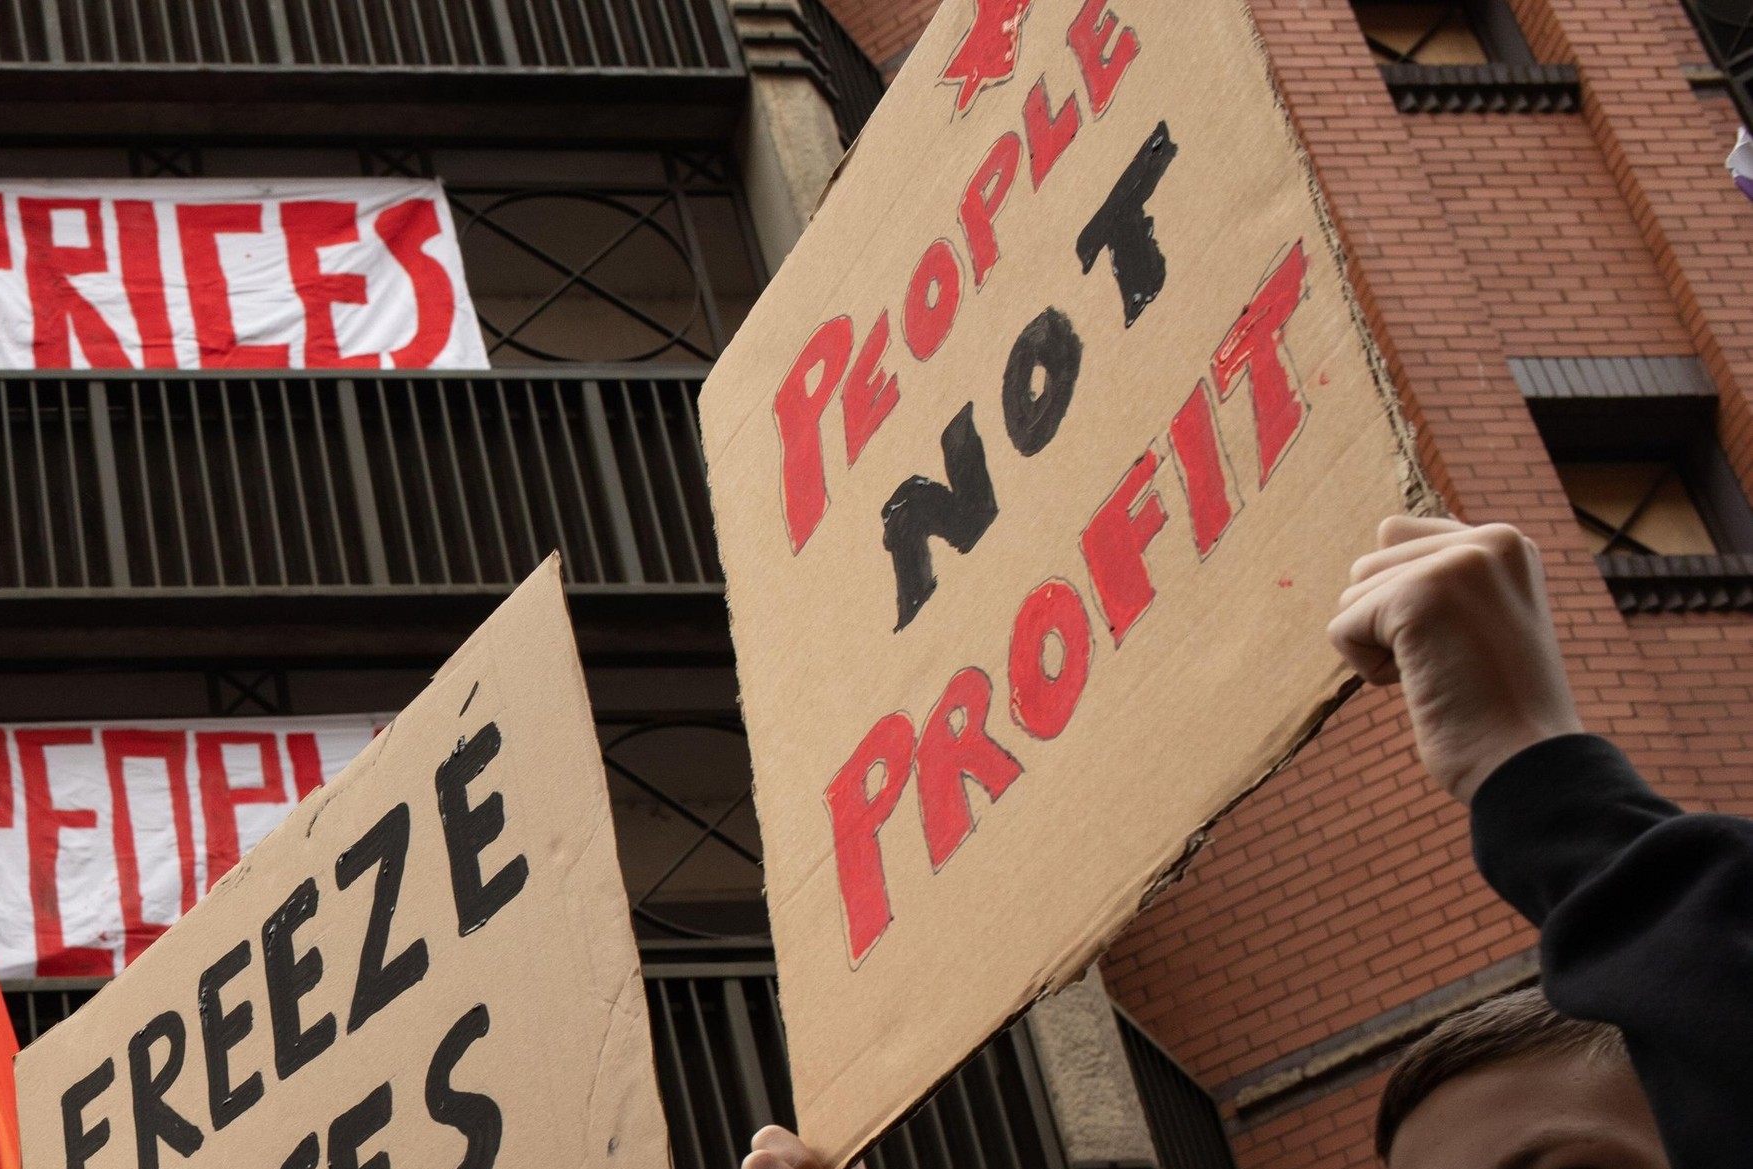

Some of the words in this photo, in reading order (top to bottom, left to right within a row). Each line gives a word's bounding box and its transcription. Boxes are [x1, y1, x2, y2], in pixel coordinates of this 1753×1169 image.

[774, 0, 1142, 556] PEOPLE
[881, 119, 1179, 633] NOT
[823, 237, 1311, 970] PROFIT
